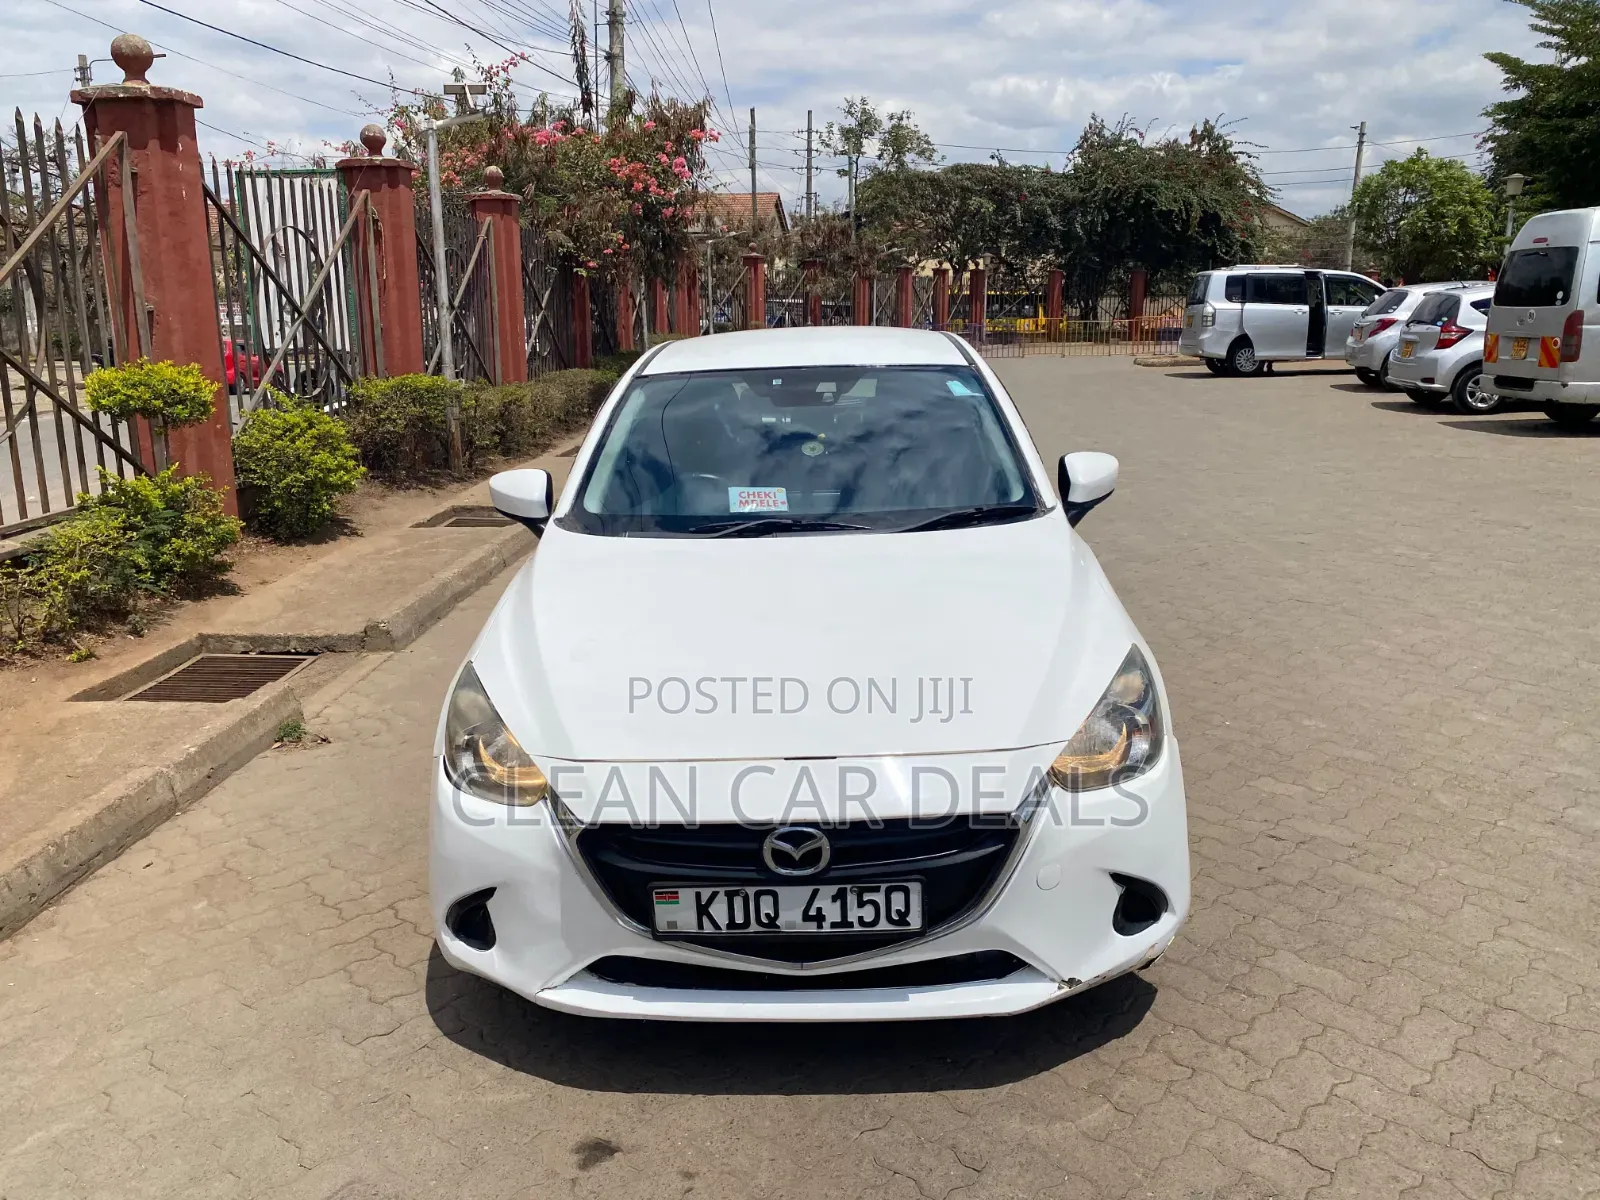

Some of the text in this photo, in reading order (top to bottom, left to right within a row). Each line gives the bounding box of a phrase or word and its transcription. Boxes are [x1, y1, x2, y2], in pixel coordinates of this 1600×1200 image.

[738, 491, 777, 499] CHEKI
[694, 889, 781, 931] KDQ
[801, 884, 912, 930] 415Q
